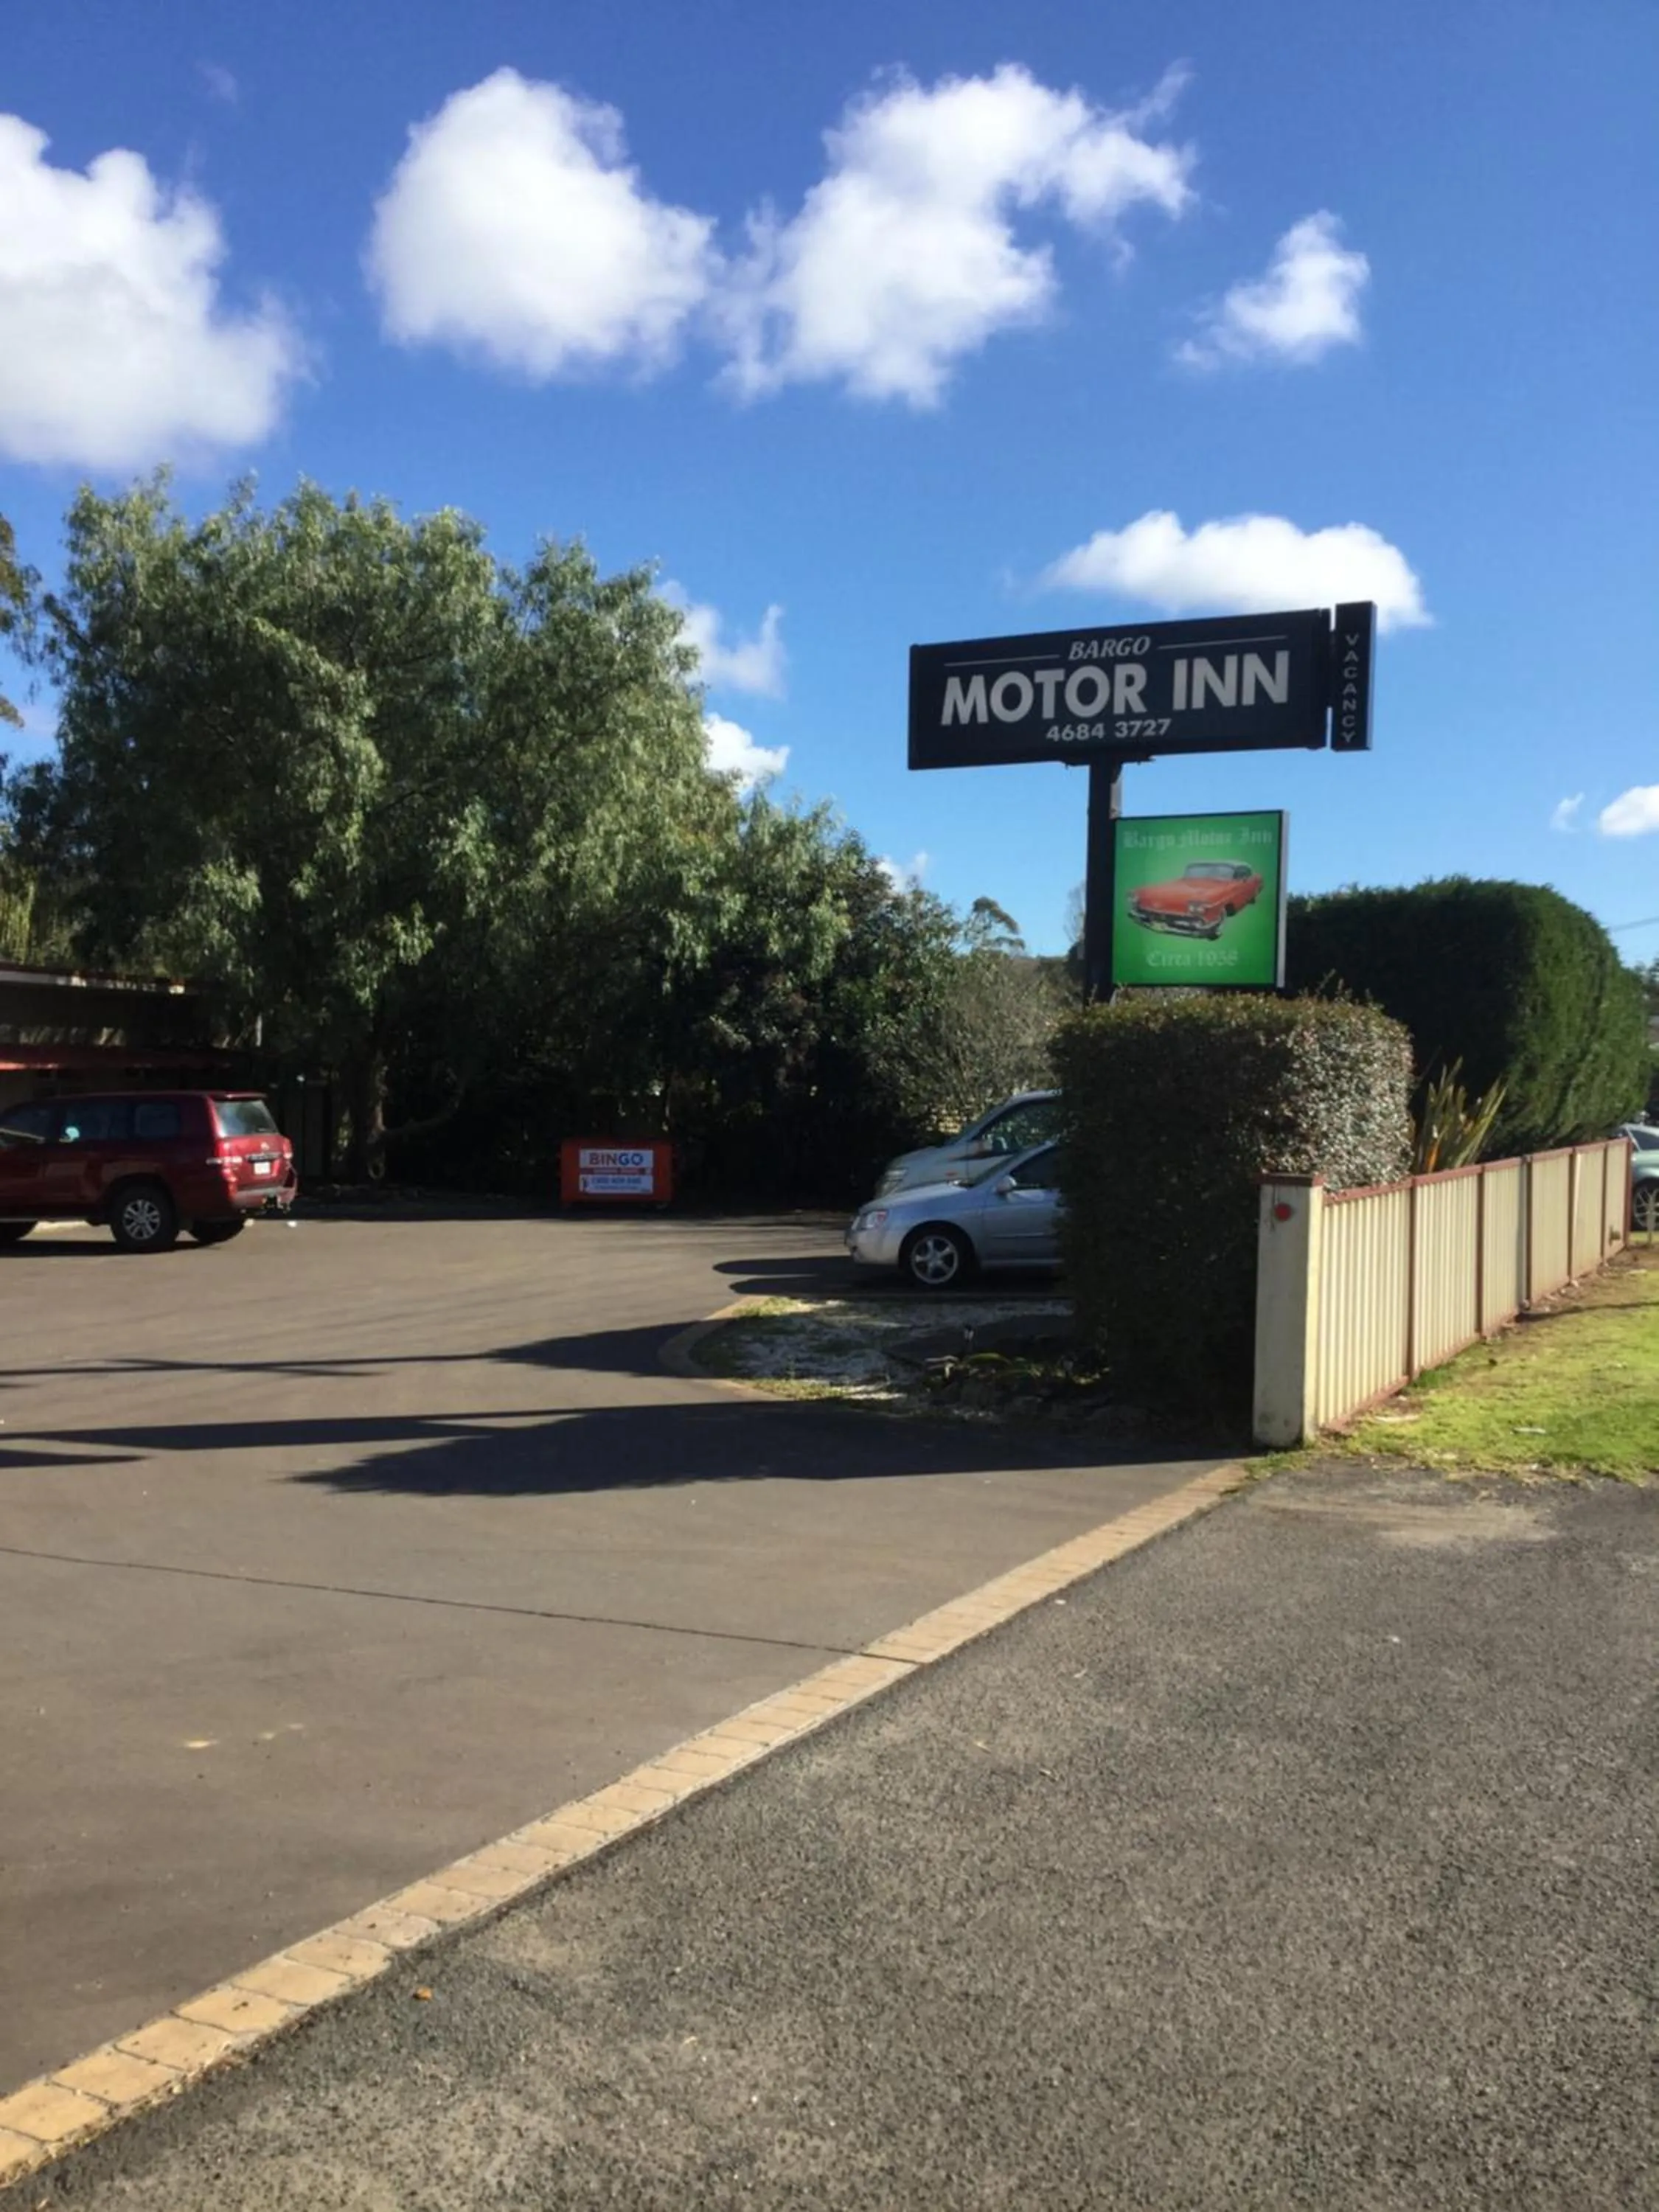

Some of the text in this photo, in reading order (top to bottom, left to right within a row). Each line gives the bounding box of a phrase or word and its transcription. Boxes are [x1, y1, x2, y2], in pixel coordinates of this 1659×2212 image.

[1068, 636, 1151, 661] BARGO
[941, 650, 1290, 726] MOTOR INN
[1341, 633, 1360, 743] VACANCY
[1046, 718, 1171, 742] 4684 3727
[589, 1152, 644, 1166] BINGO
